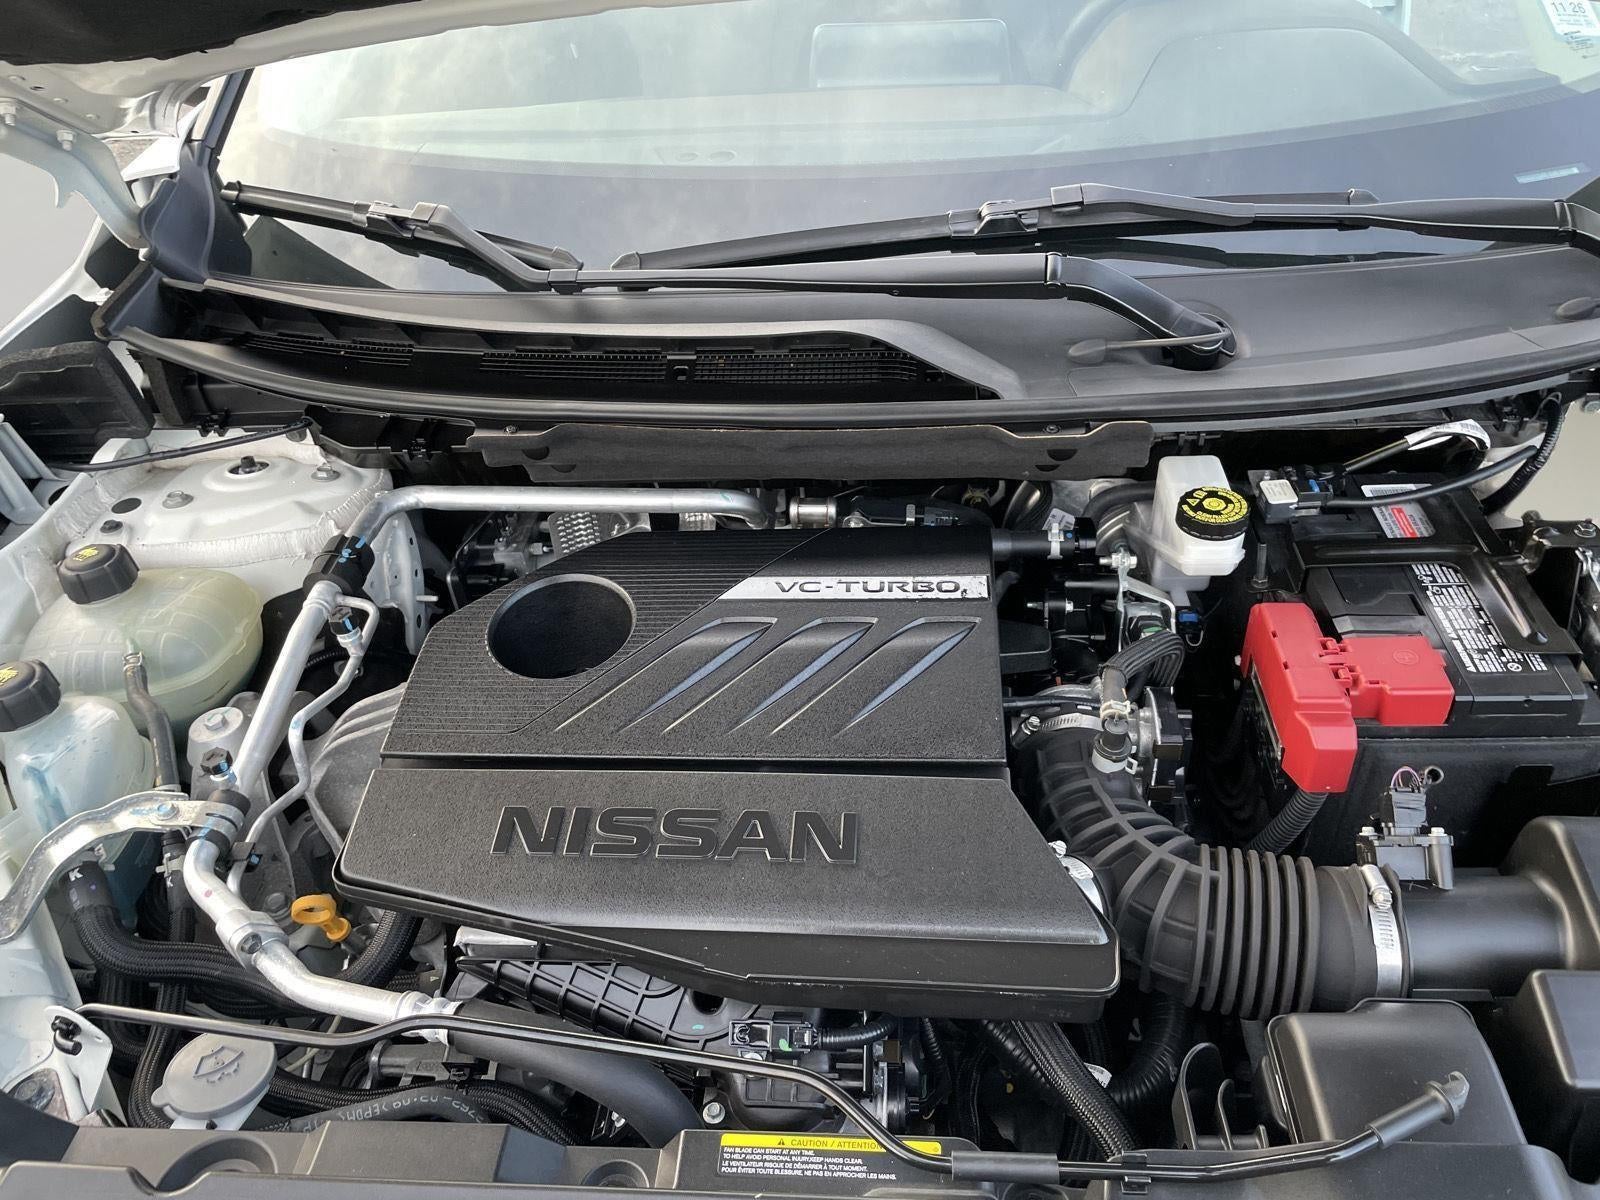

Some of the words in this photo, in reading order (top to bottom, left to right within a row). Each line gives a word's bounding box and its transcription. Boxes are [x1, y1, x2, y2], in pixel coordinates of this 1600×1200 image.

[775, 580, 961, 594] VC-TURBO
[490, 805, 859, 865] NISSAN
[790, 1139, 828, 1147] CAUTION
[762, 1154, 792, 1162] PERSONAL
[729, 1160, 764, 1168] VENTILATEUR
[793, 1161, 823, 1170] DÉMARRER
[844, 1164, 868, 1172] MOMENT.
[737, 1166, 756, 1174] ÉVITER
[774, 1168, 804, 1177] BLESSURE,
[832, 1171, 866, 1179] APPROCHER
